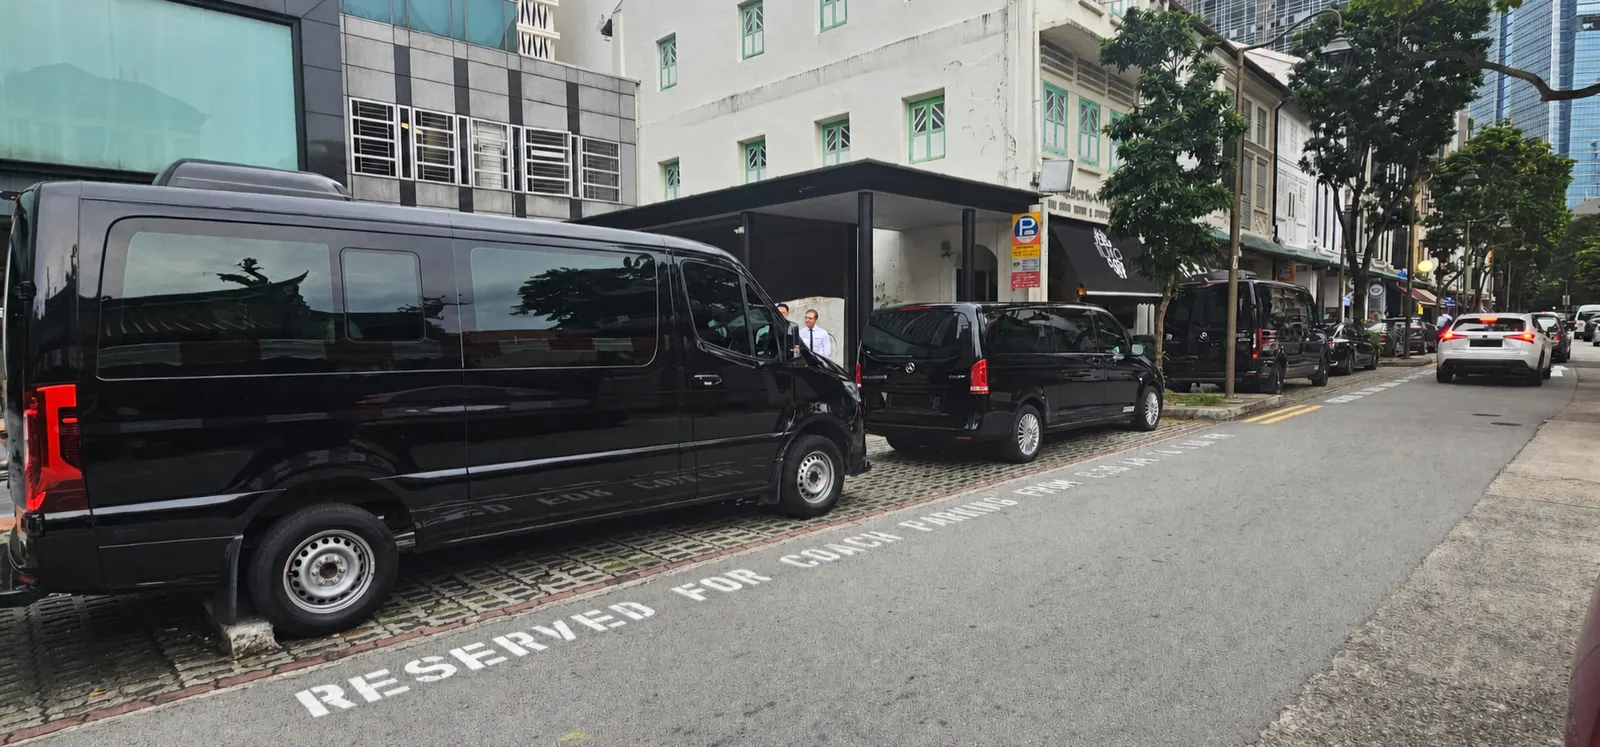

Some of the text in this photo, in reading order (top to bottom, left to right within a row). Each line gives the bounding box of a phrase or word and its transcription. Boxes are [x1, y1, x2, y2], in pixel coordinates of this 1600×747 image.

[1019, 217, 1035, 236] P
[294, 601, 656, 718] RESERVED
[670, 568, 773, 602] FOR
[780, 530, 904, 568] COACH
[899, 497, 1019, 532] PARKING
